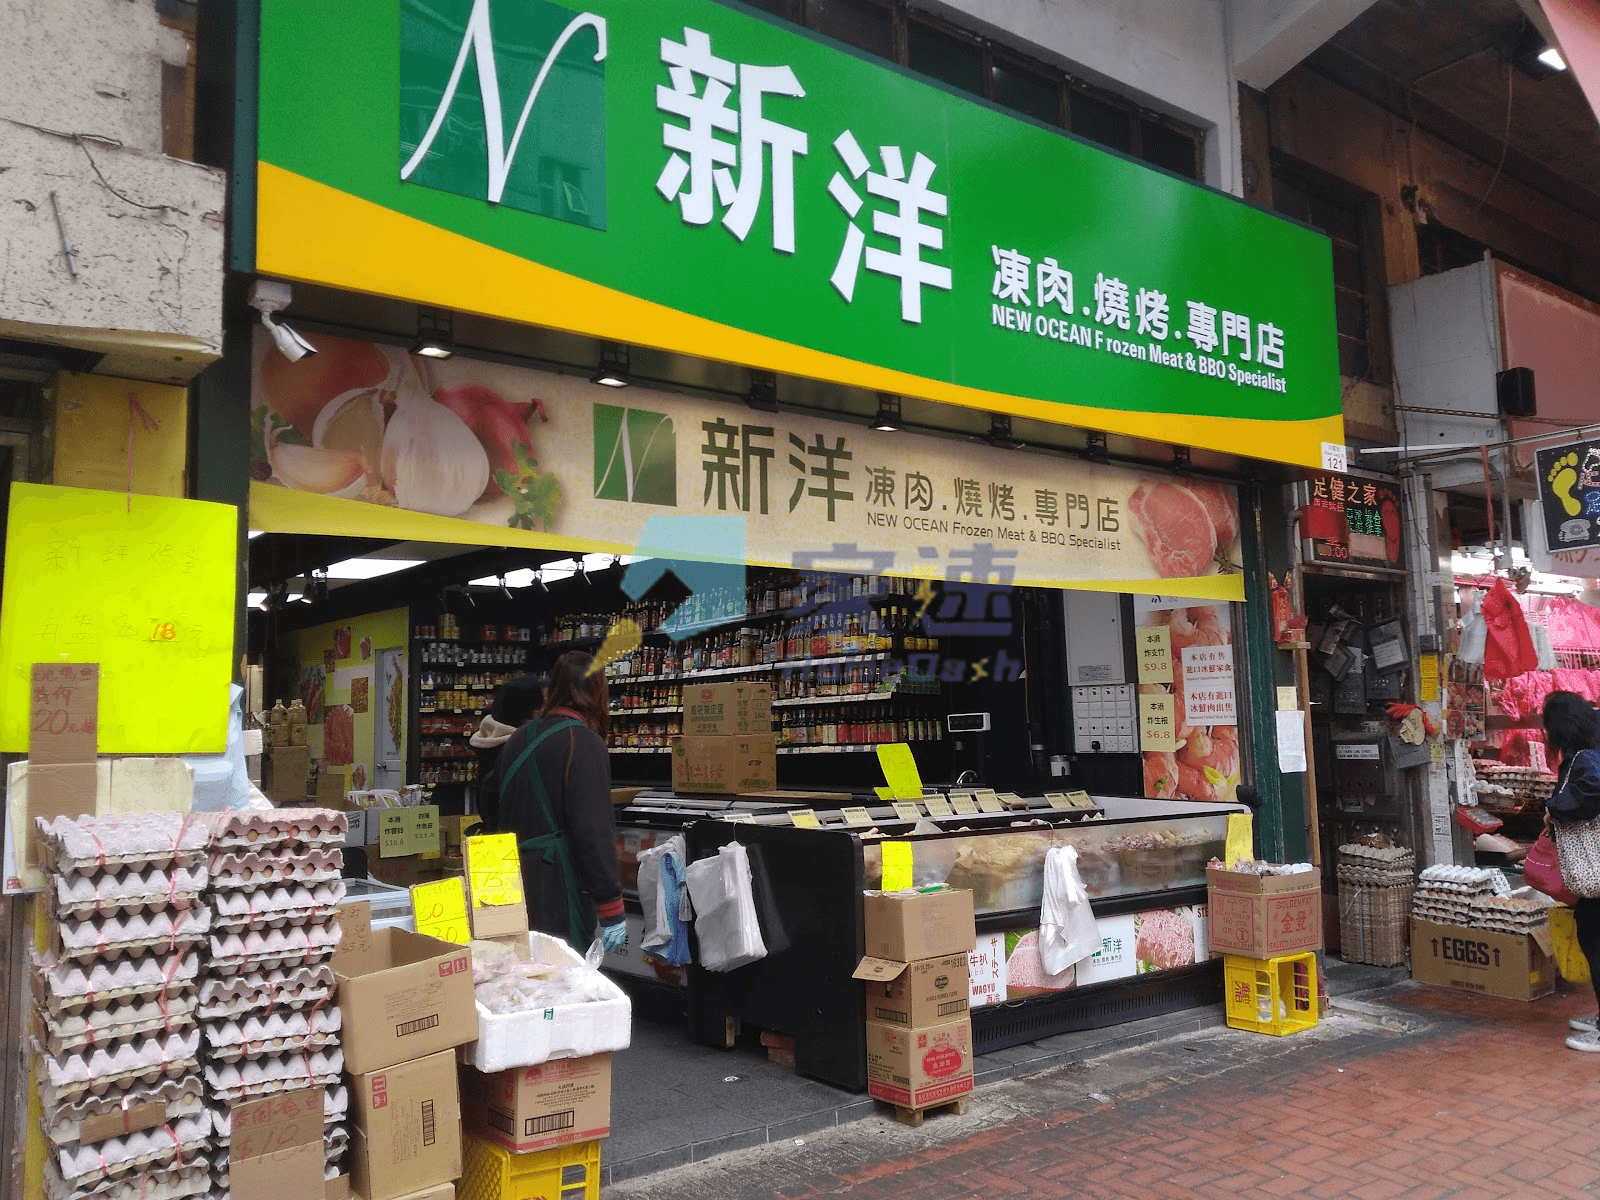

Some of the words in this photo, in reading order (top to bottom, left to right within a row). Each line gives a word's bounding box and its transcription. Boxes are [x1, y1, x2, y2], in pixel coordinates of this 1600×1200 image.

[656, 27, 952, 323] 新洋
[992, 304, 1032, 333] NEW
[1035, 315, 1092, 349] OCEAN
[1095, 330, 1147, 361] Frozen
[1149, 343, 1184, 371] Meat
[1186, 352, 1197, 372] &
[1228, 361, 1287, 394] Specialist
[701, 417, 854, 522] 新洋
[1328, 457, 1342, 470] 121
[867, 512, 898, 528] NEW
[903, 516, 948, 534] OCEAN
[953, 522, 994, 539] Frozen
[998, 527, 1025, 542] Meat
[1029, 531, 1037, 542] &
[1041, 532, 1066, 546] BBQ
[1069, 535, 1121, 551] Specialist
[1147, 635, 1161, 643] 本港
[1144, 649, 1165, 657] 炸支竹
[1191, 652, 1225, 661] 本店有售
[1144, 662, 1168, 671] $9.8
[1150, 703, 1165, 711] 本港
[1190, 703, 1233, 713] 冰鮮肉出售
[1146, 730, 1170, 739] $6.8
[384, 839, 405, 847] $16.8
[1276, 898, 1302, 910] GOLDEN
[1102, 936, 1122, 953] 新洋
[1268, 940, 1289, 949] SALTED
[1303, 935, 1317, 945] EGGS
[1442, 936, 1490, 966] EGGS
[970, 953, 989, 968] 牛扒
[972, 983, 996, 996] WAGYU
